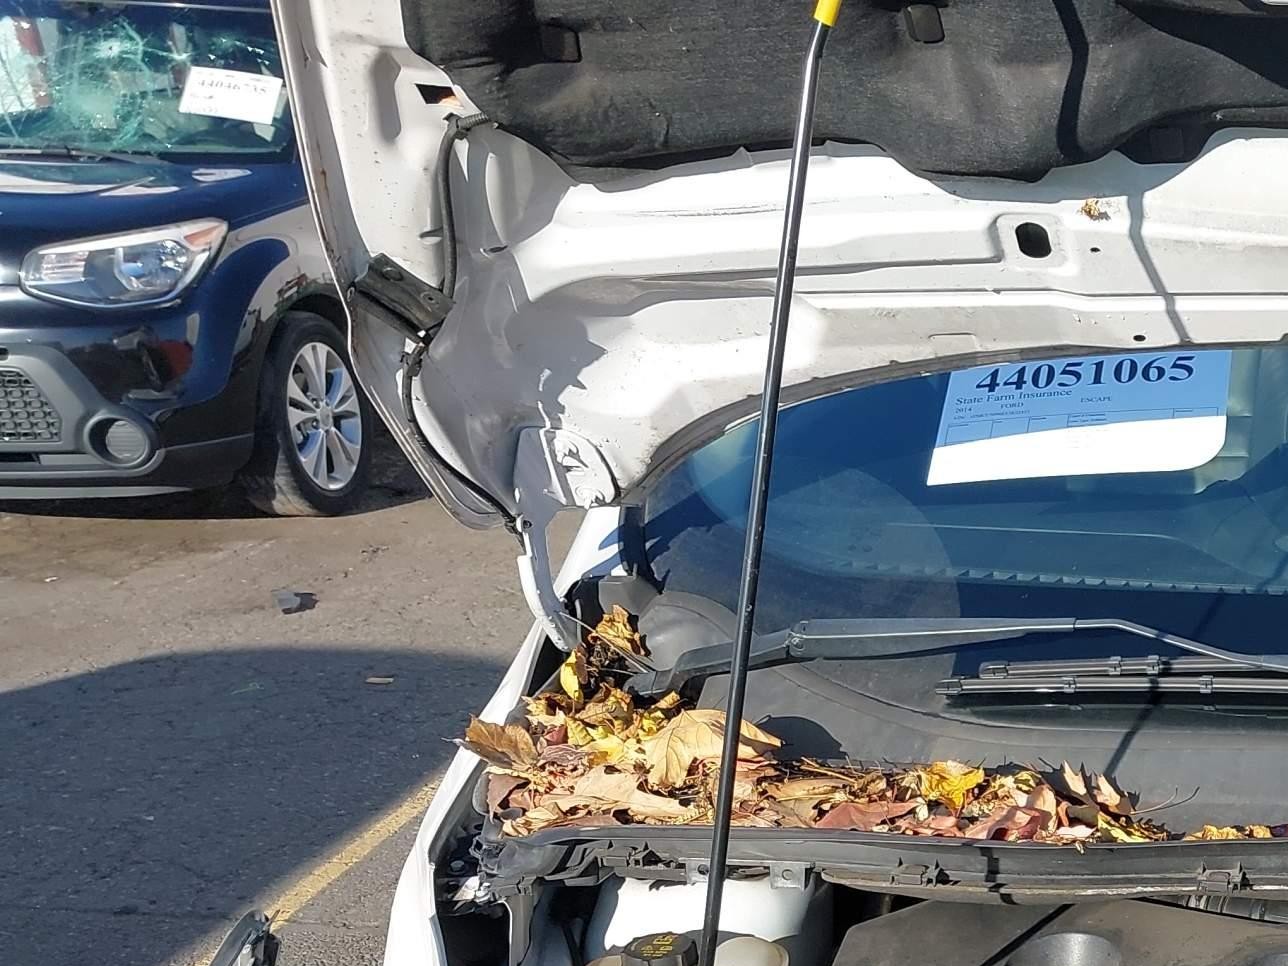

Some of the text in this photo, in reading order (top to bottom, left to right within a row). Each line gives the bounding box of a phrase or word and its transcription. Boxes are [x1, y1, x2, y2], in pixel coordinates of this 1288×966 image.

[975, 355, 1196, 393] 44051065
[955, 389, 1073, 406] State Farm Insurance
